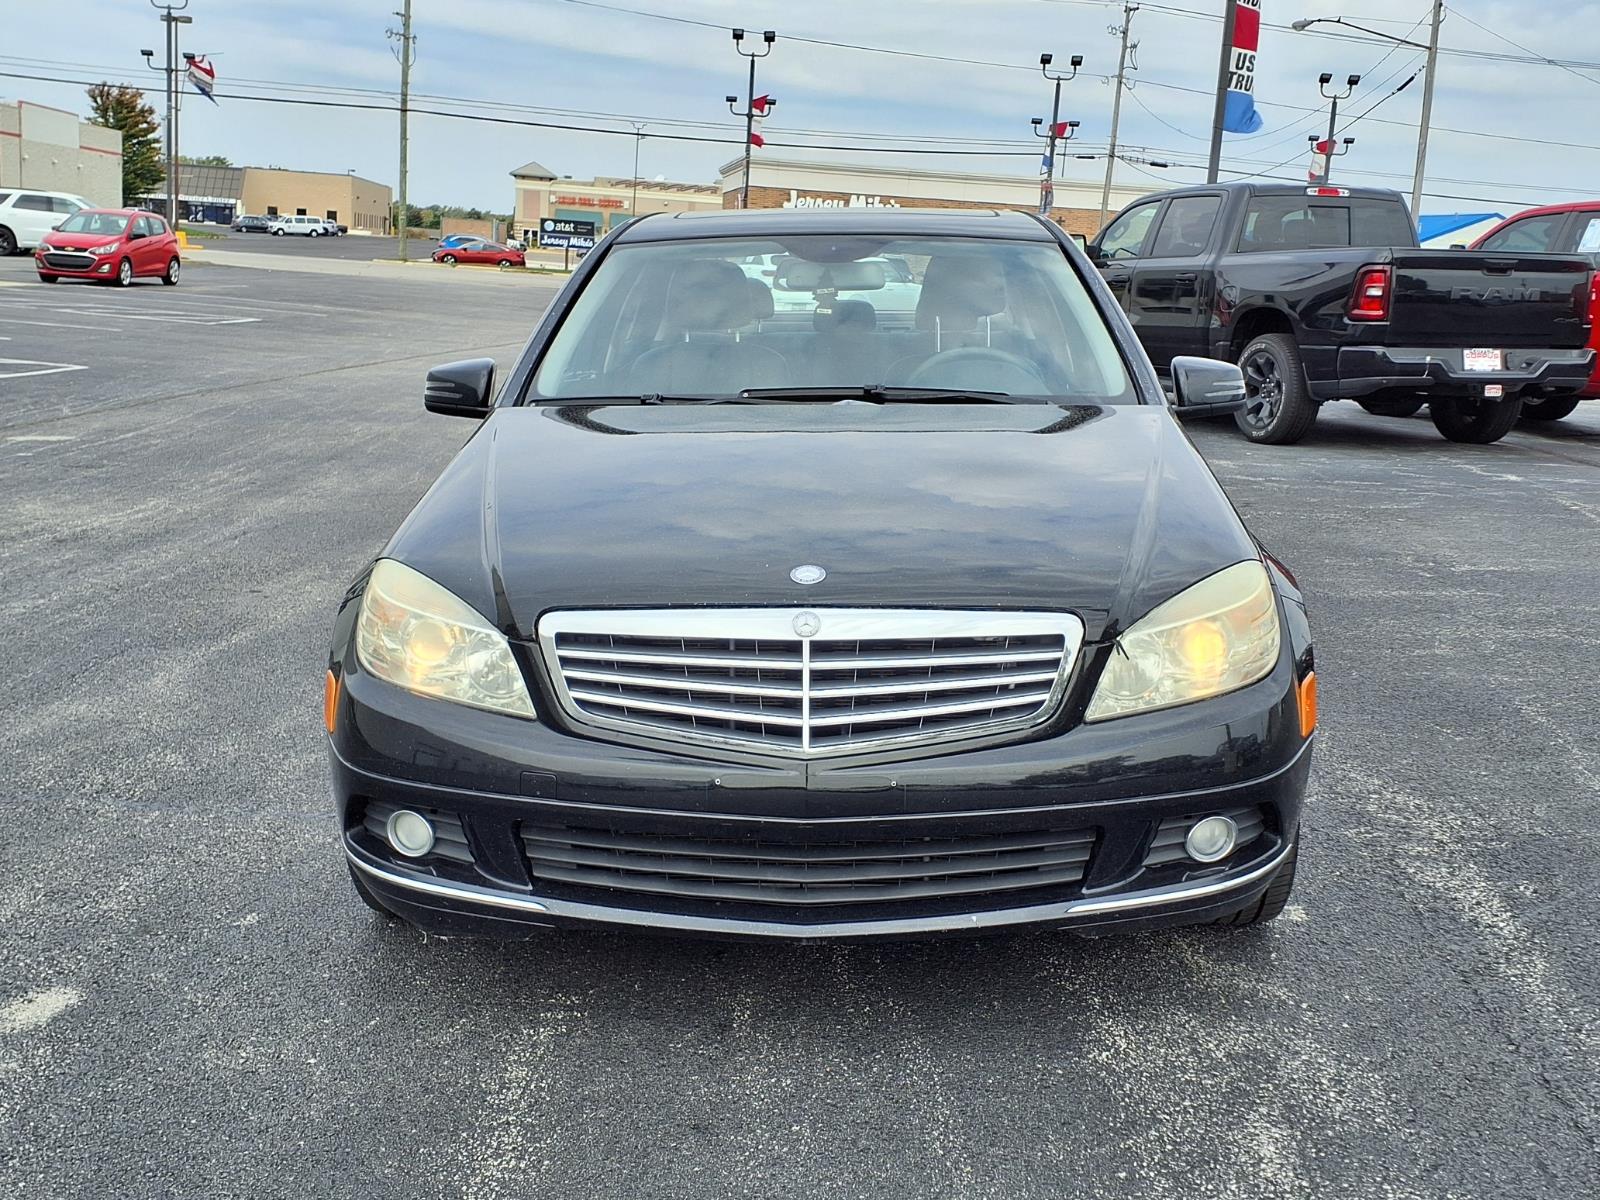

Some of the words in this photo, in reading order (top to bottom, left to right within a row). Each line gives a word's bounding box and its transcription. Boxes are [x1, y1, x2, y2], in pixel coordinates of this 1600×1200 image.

[1228, 71, 1254, 93] TRU
[555, 222, 575, 232] at&t
[541, 235, 569, 248] Jersey
[1450, 286, 1541, 301] RAM
